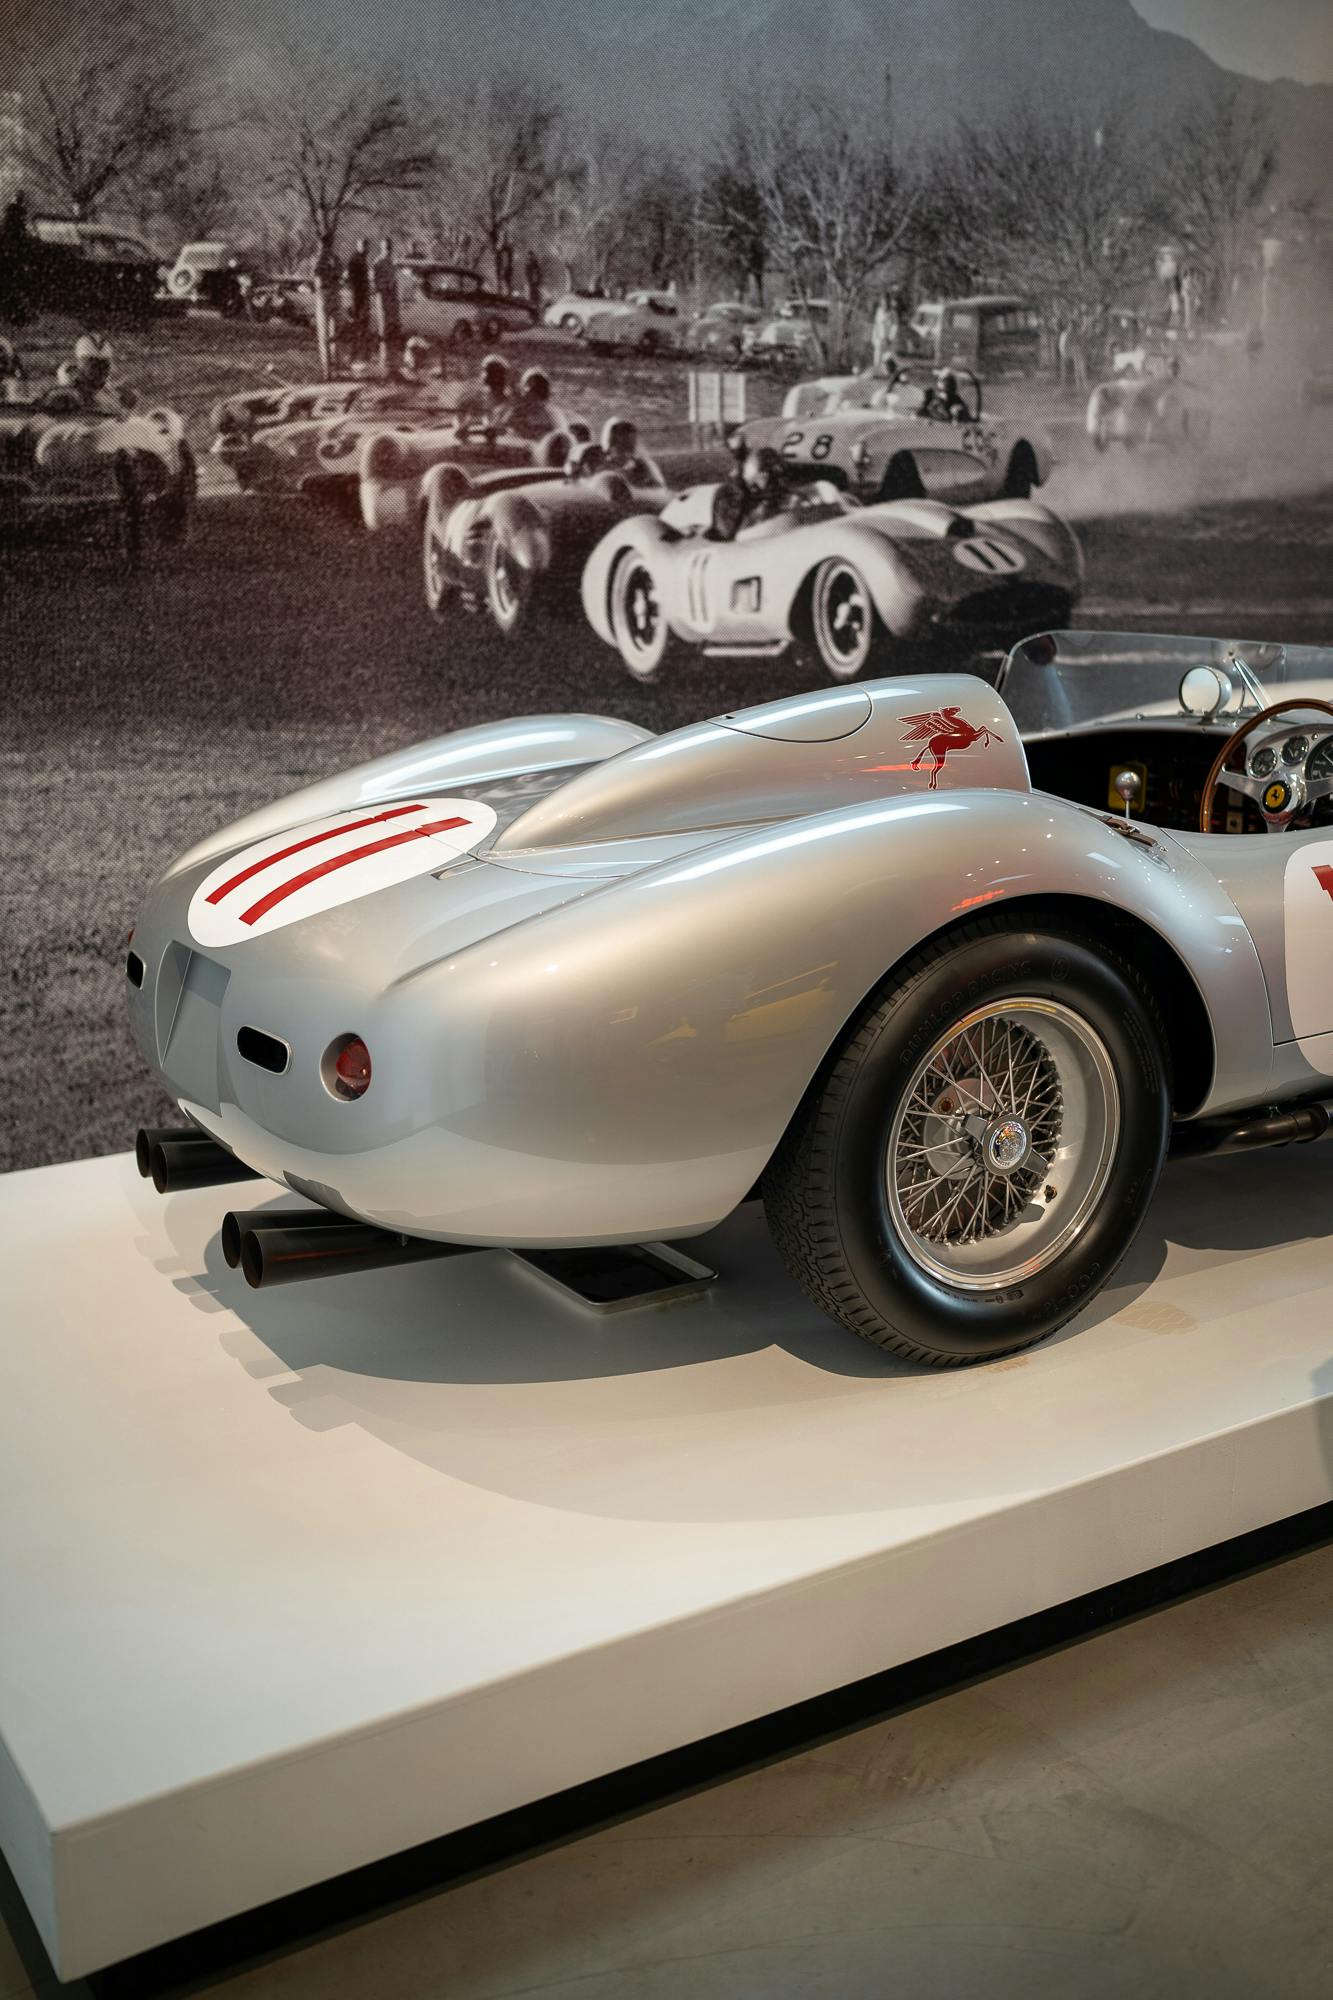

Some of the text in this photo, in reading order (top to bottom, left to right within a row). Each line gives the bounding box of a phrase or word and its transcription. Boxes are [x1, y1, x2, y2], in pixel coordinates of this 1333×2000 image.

[782, 432, 833, 461] 28
[964, 541, 1017, 570] 11
[205, 804, 473, 926] 11
[898, 991, 966, 1066] DUNLOP
